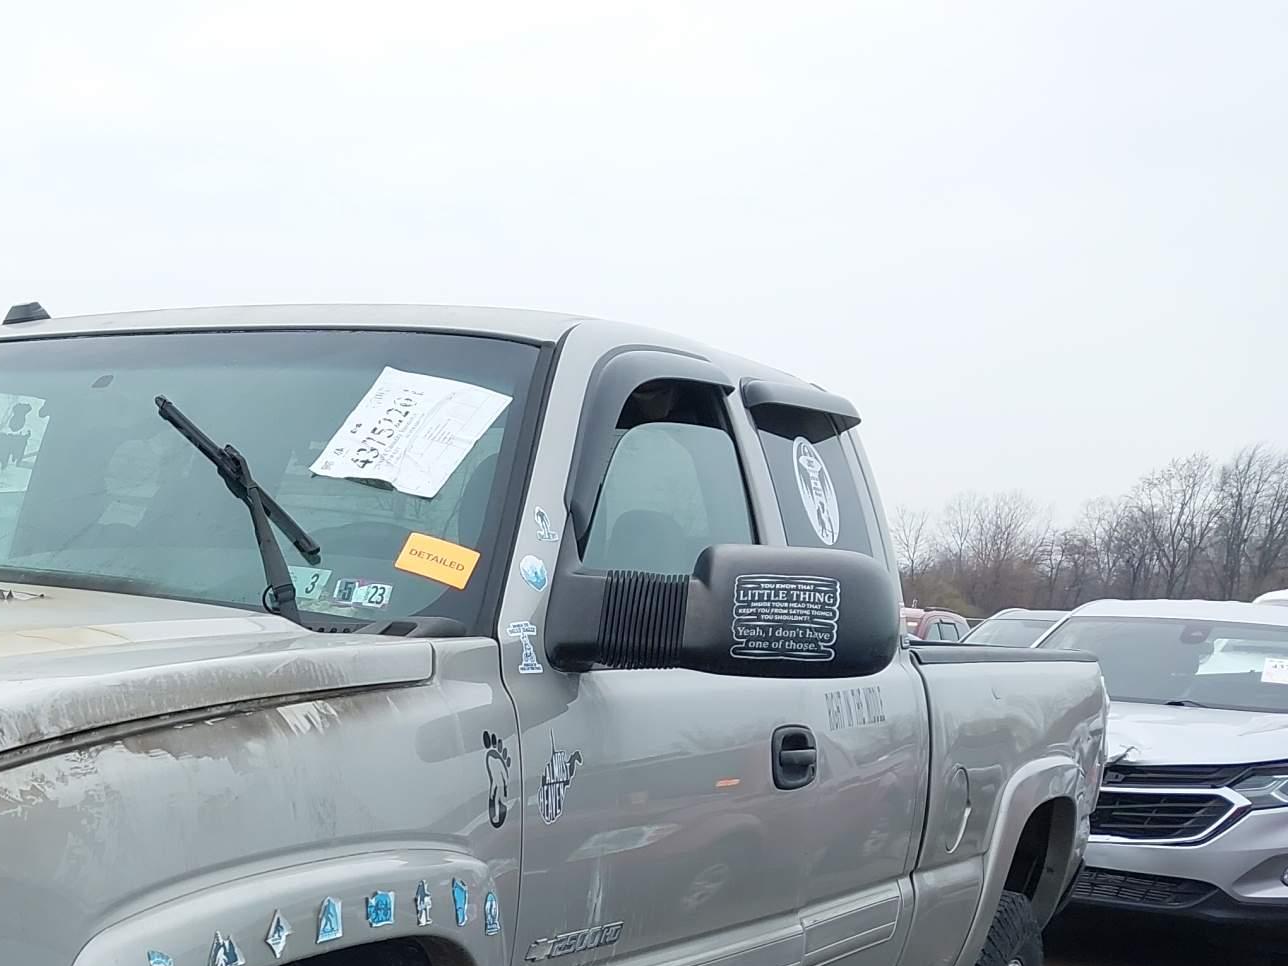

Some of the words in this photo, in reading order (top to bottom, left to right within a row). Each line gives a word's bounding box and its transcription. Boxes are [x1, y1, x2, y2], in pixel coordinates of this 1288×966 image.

[408, 548, 465, 572] DETAILED
[305, 573, 320, 594] 3
[368, 585, 386, 605] 23
[739, 590, 787, 601] LITTLE
[790, 590, 834, 604] THING
[737, 626, 766, 638] Yeah,
[768, 627, 773, 636] I
[775, 627, 804, 639] don't
[806, 628, 831, 640] have
[748, 641, 769, 649] one
[771, 640, 784, 649] of
[785, 640, 818, 651] those.
